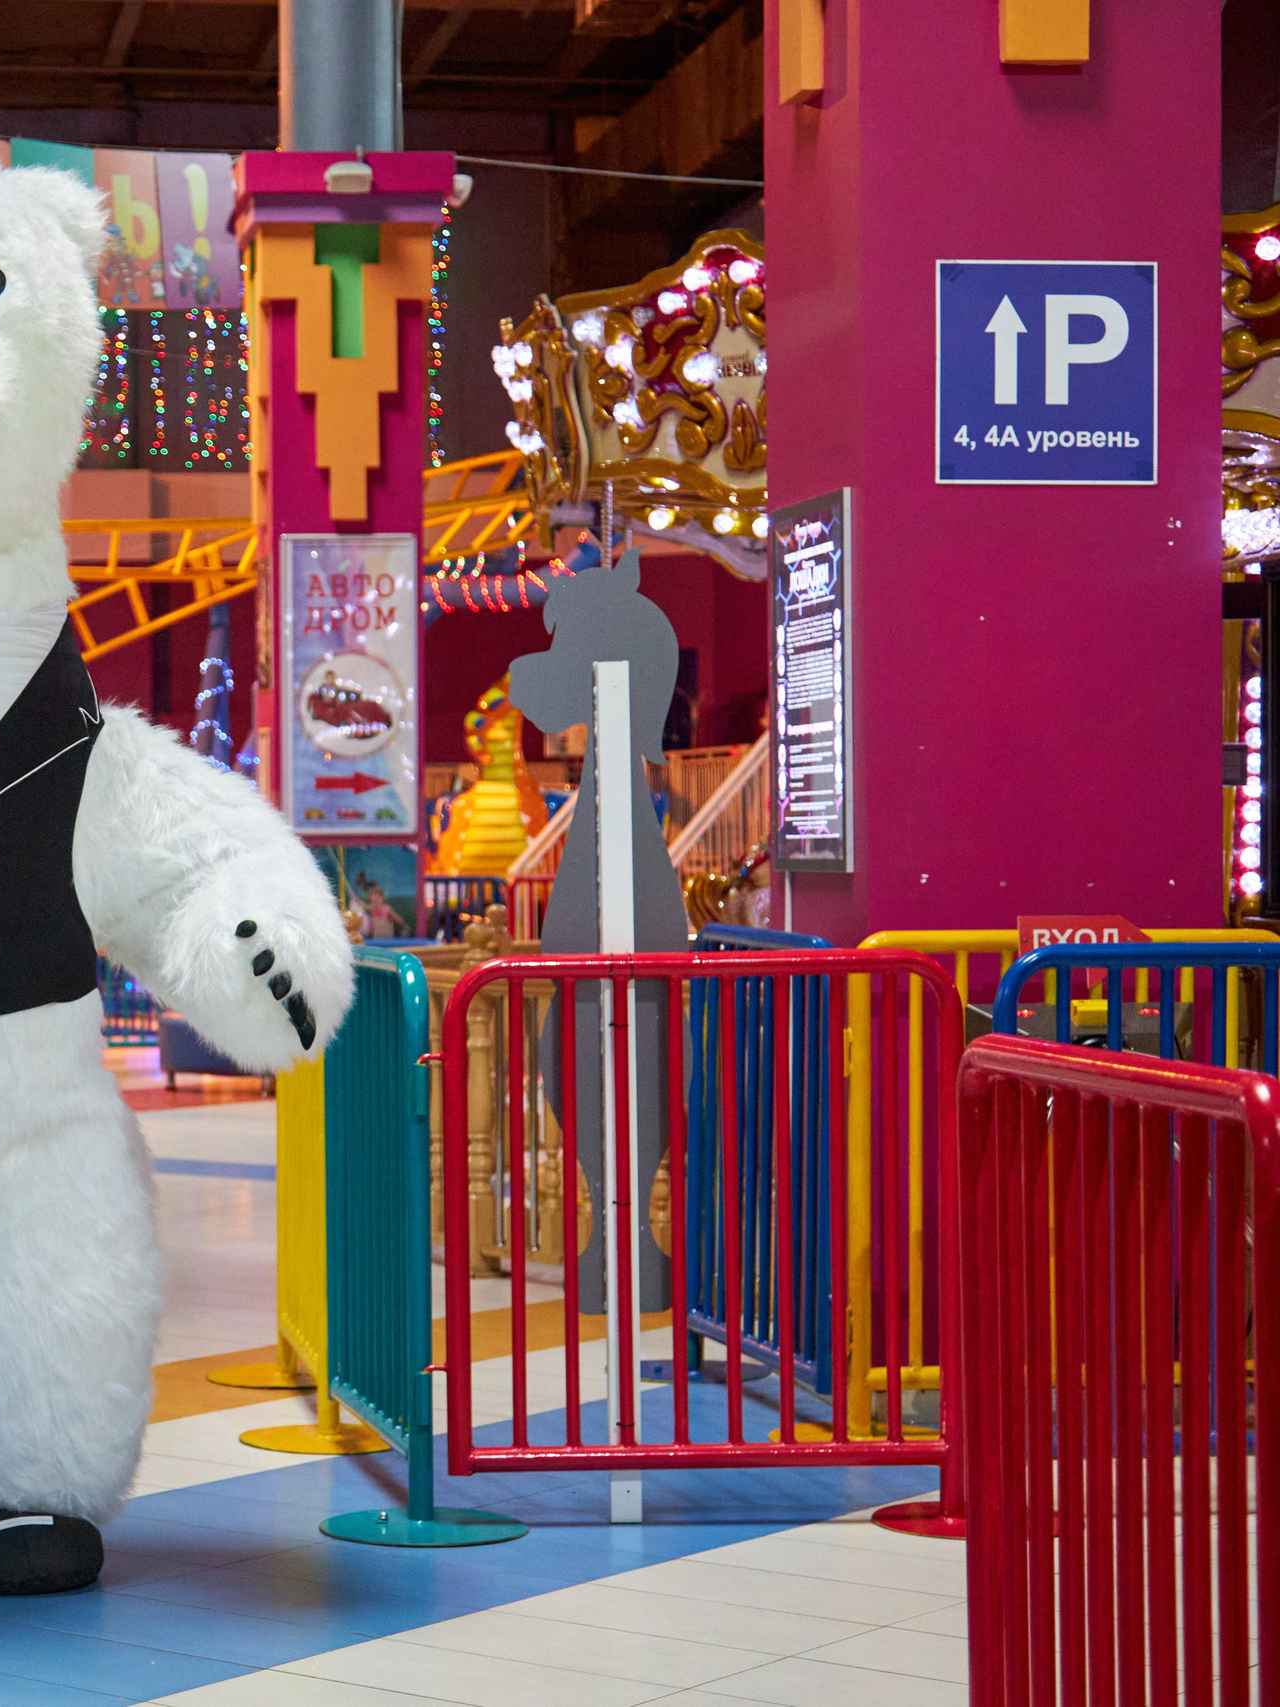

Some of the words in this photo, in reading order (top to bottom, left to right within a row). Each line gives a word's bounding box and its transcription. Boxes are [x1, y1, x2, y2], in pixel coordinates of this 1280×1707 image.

[1045, 294, 1129, 405] P
[953, 424, 976, 451] 4,
[984, 424, 1020, 447] 4А
[1026, 430, 1140, 453] уровень
[306, 573, 395, 598] АВТО
[303, 606, 397, 634] ДРОМ
